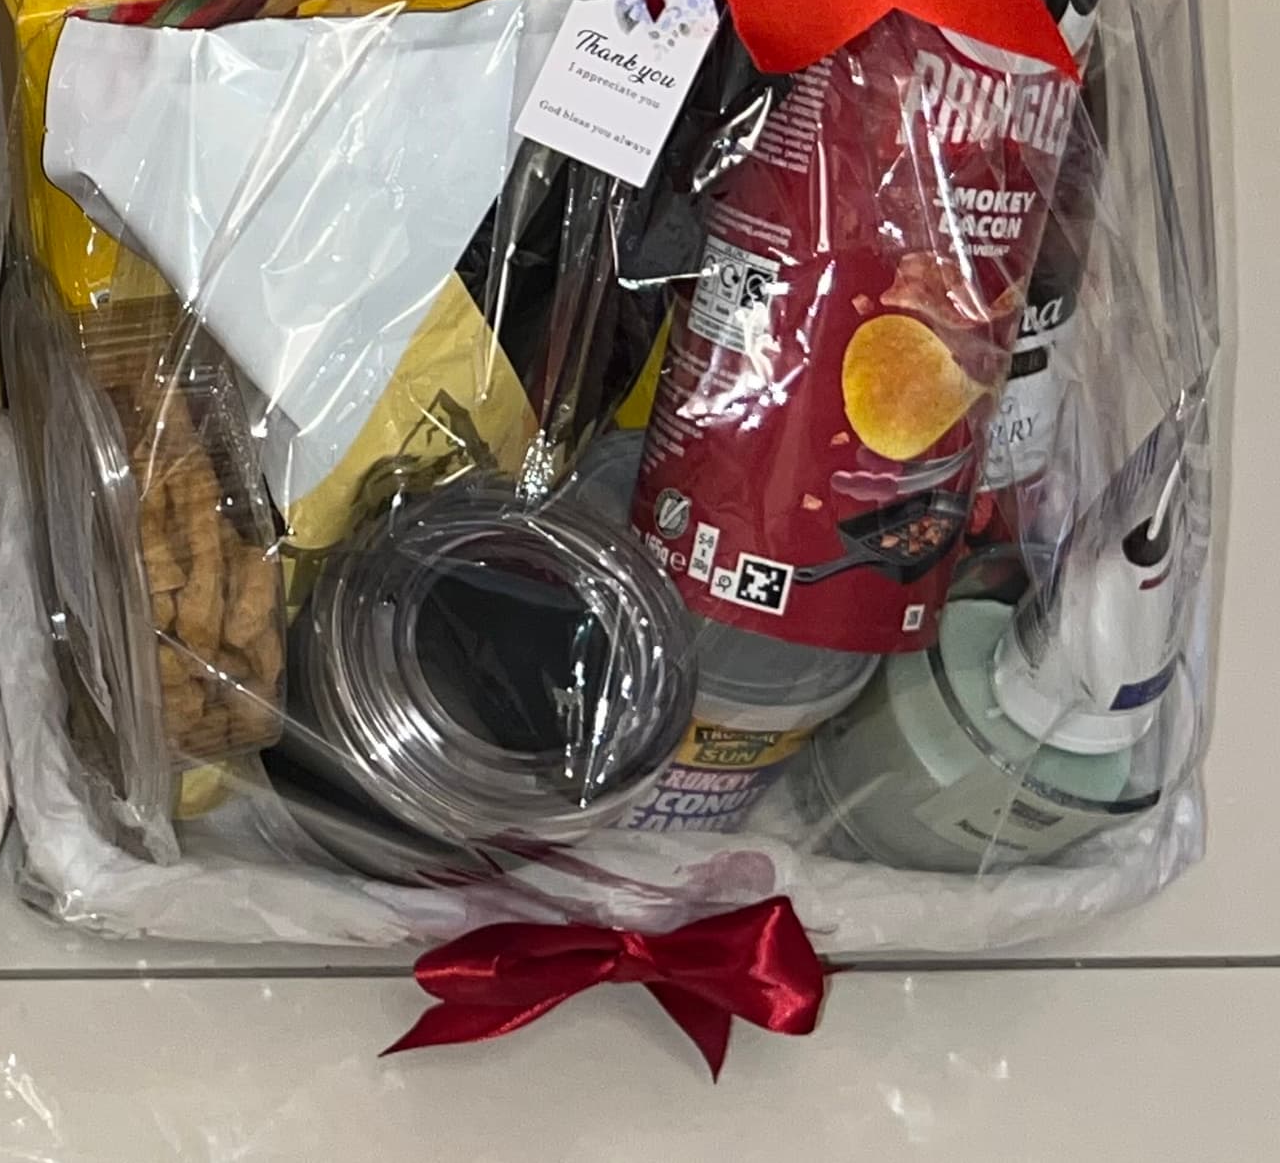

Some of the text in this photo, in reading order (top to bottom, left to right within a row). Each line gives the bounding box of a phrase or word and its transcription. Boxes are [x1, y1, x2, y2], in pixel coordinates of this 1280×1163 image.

[567, 60, 661, 110] I appreciate you
[575, 28, 677, 90] Thank you
[538, 99, 653, 157] God bless you always
[700, 748, 757, 763] SUN
